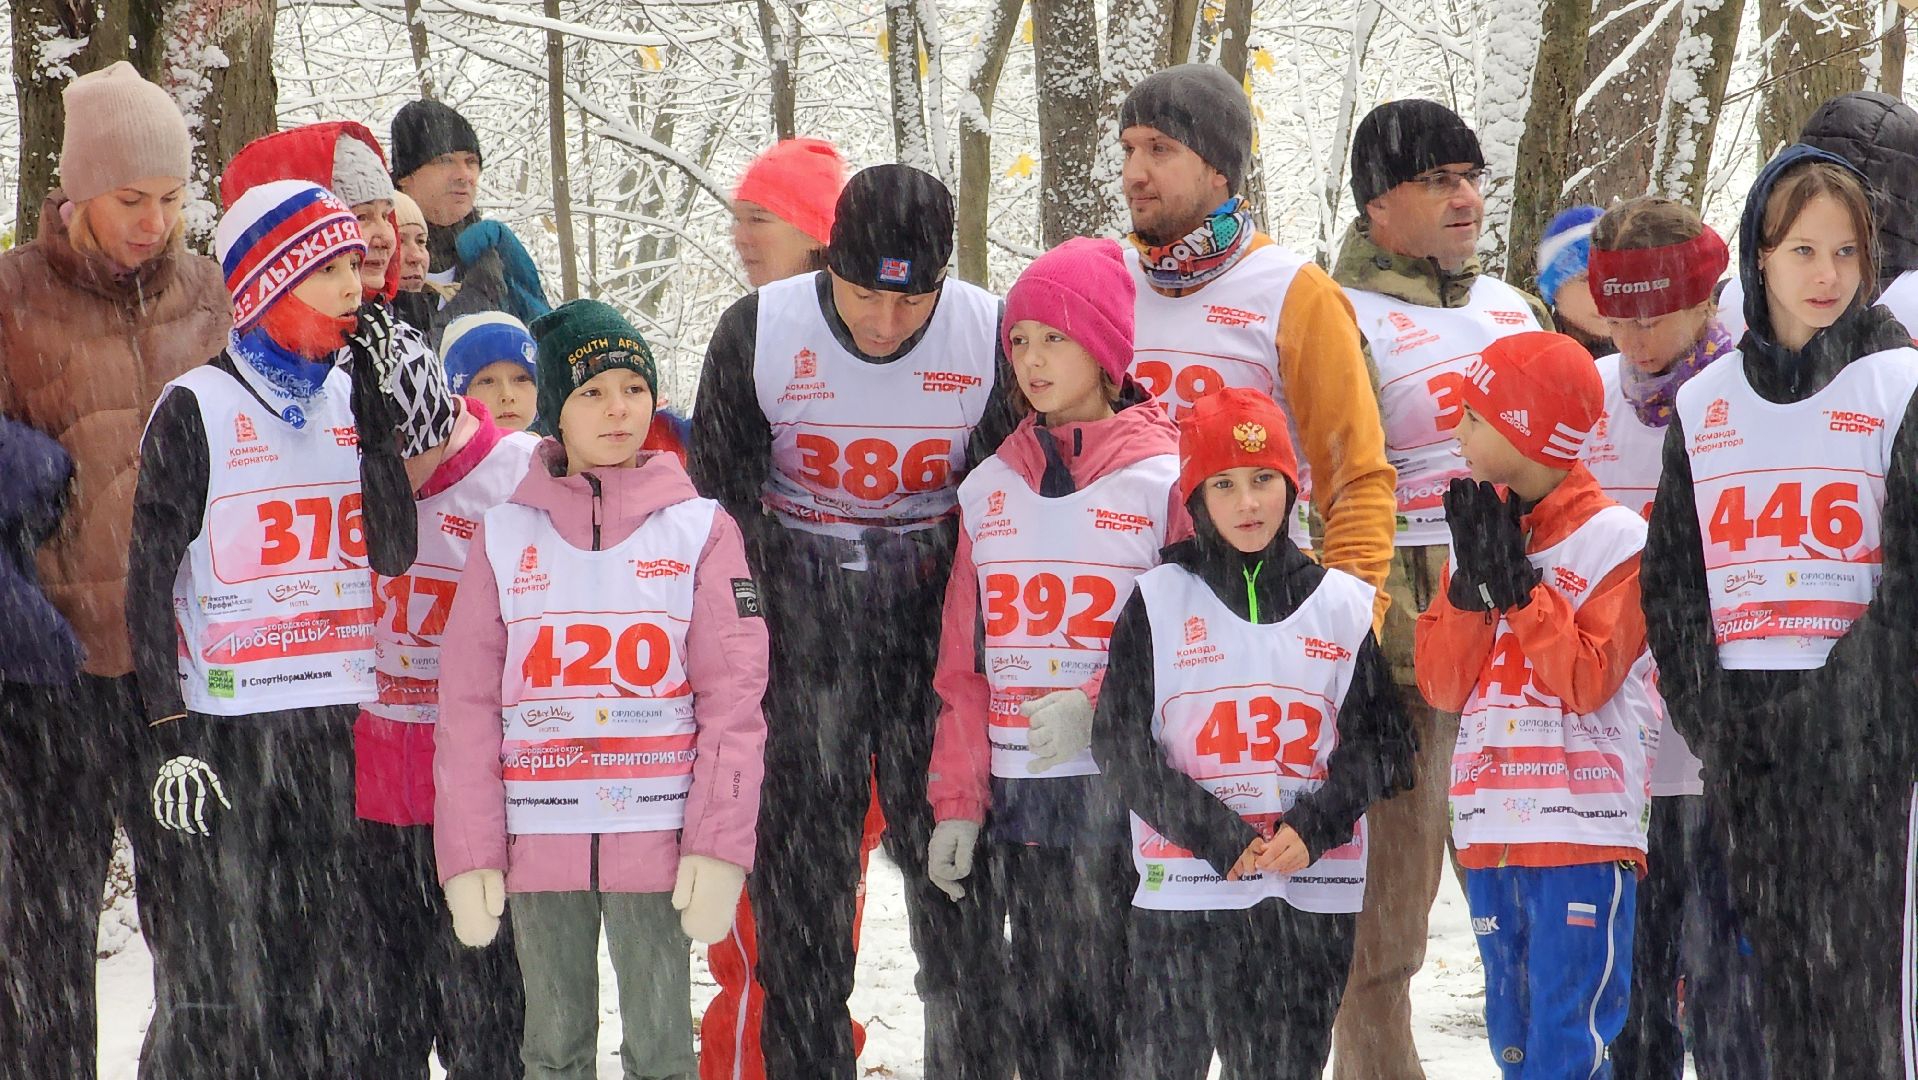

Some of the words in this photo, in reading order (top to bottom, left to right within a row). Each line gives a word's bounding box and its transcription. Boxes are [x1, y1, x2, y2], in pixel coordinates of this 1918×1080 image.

[258, 221, 359, 302] ЛЫЖНЯ
[568, 338, 609, 365] SOUTH
[1500, 412, 1531, 437] adidas
[796, 433, 952, 501] 386
[256, 492, 369, 566] 376
[1094, 520, 1143, 535] СПОРТ
[1708, 482, 1864, 552] 446
[986, 572, 1117, 639] 392
[522, 622, 671, 688] 420
[591, 751, 675, 767] ТЕРРИТОРИЯ
[1195, 696, 1322, 765] 432
